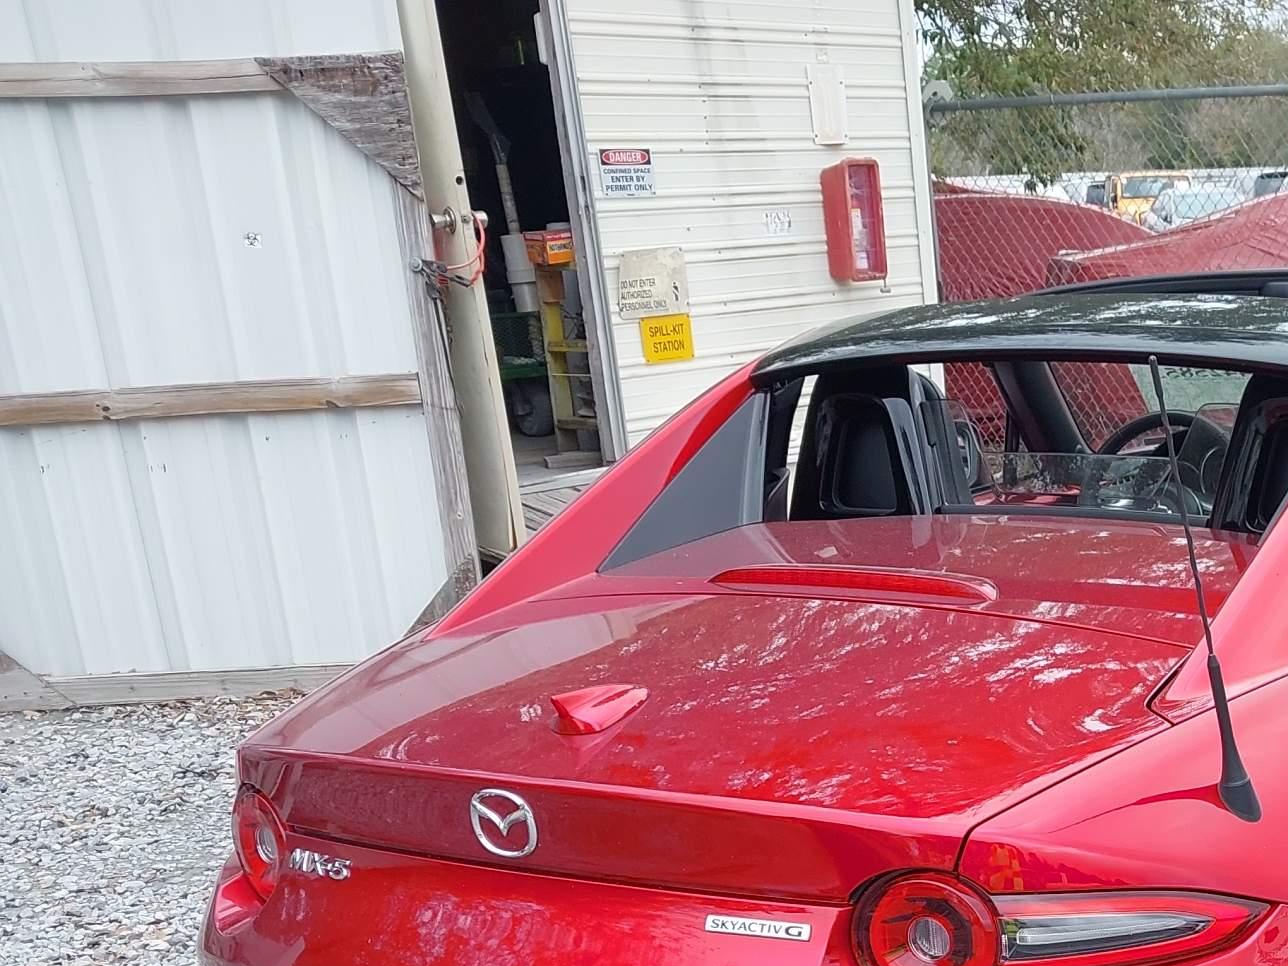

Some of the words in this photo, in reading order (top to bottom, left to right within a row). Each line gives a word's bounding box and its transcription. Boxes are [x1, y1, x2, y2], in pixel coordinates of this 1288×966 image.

[608, 152, 642, 163] DANGER
[611, 175, 634, 183] ENTER
[605, 184, 632, 192] PERMIT
[634, 183, 653, 191] ONLY
[620, 280, 628, 290] DO
[628, 279, 638, 289] NOT
[639, 278, 656, 288] ENTER
[621, 289, 653, 300] AUTHORIZED
[621, 301, 654, 312] PERSONNEL
[653, 299, 667, 309] ONLY
[649, 323, 685, 338] SPILL-KIT
[653, 339, 685, 353] STATION
[289, 848, 353, 880] MX-5
